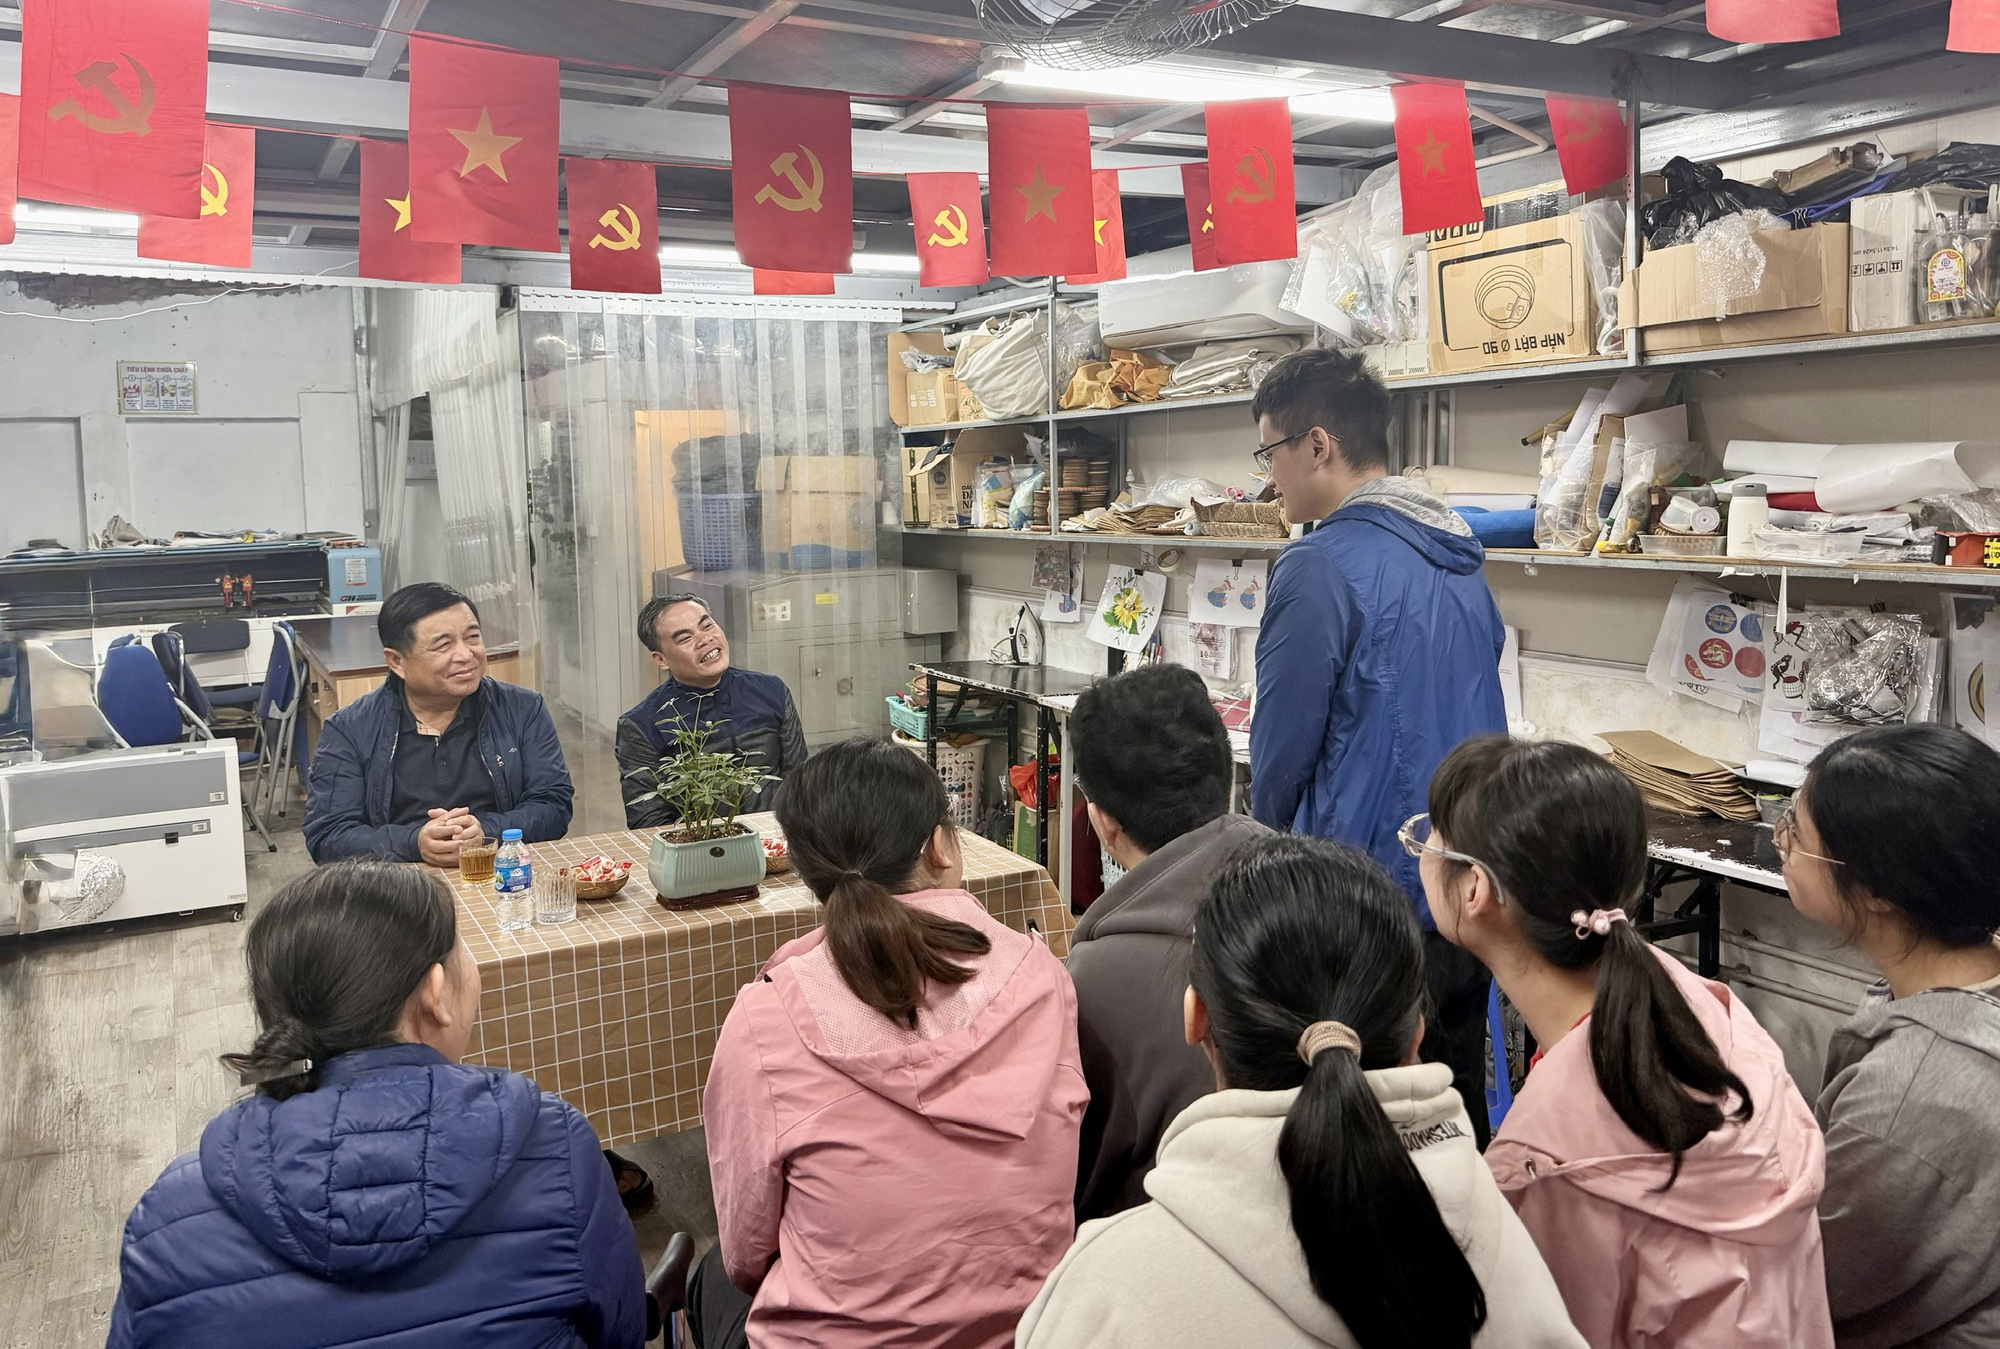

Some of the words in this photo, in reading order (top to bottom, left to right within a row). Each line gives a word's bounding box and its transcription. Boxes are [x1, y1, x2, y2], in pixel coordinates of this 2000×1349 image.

[1482, 341, 1498, 354] 90
[1514, 334, 1538, 353] BẬT
[1540, 332, 1566, 353] NẮP
